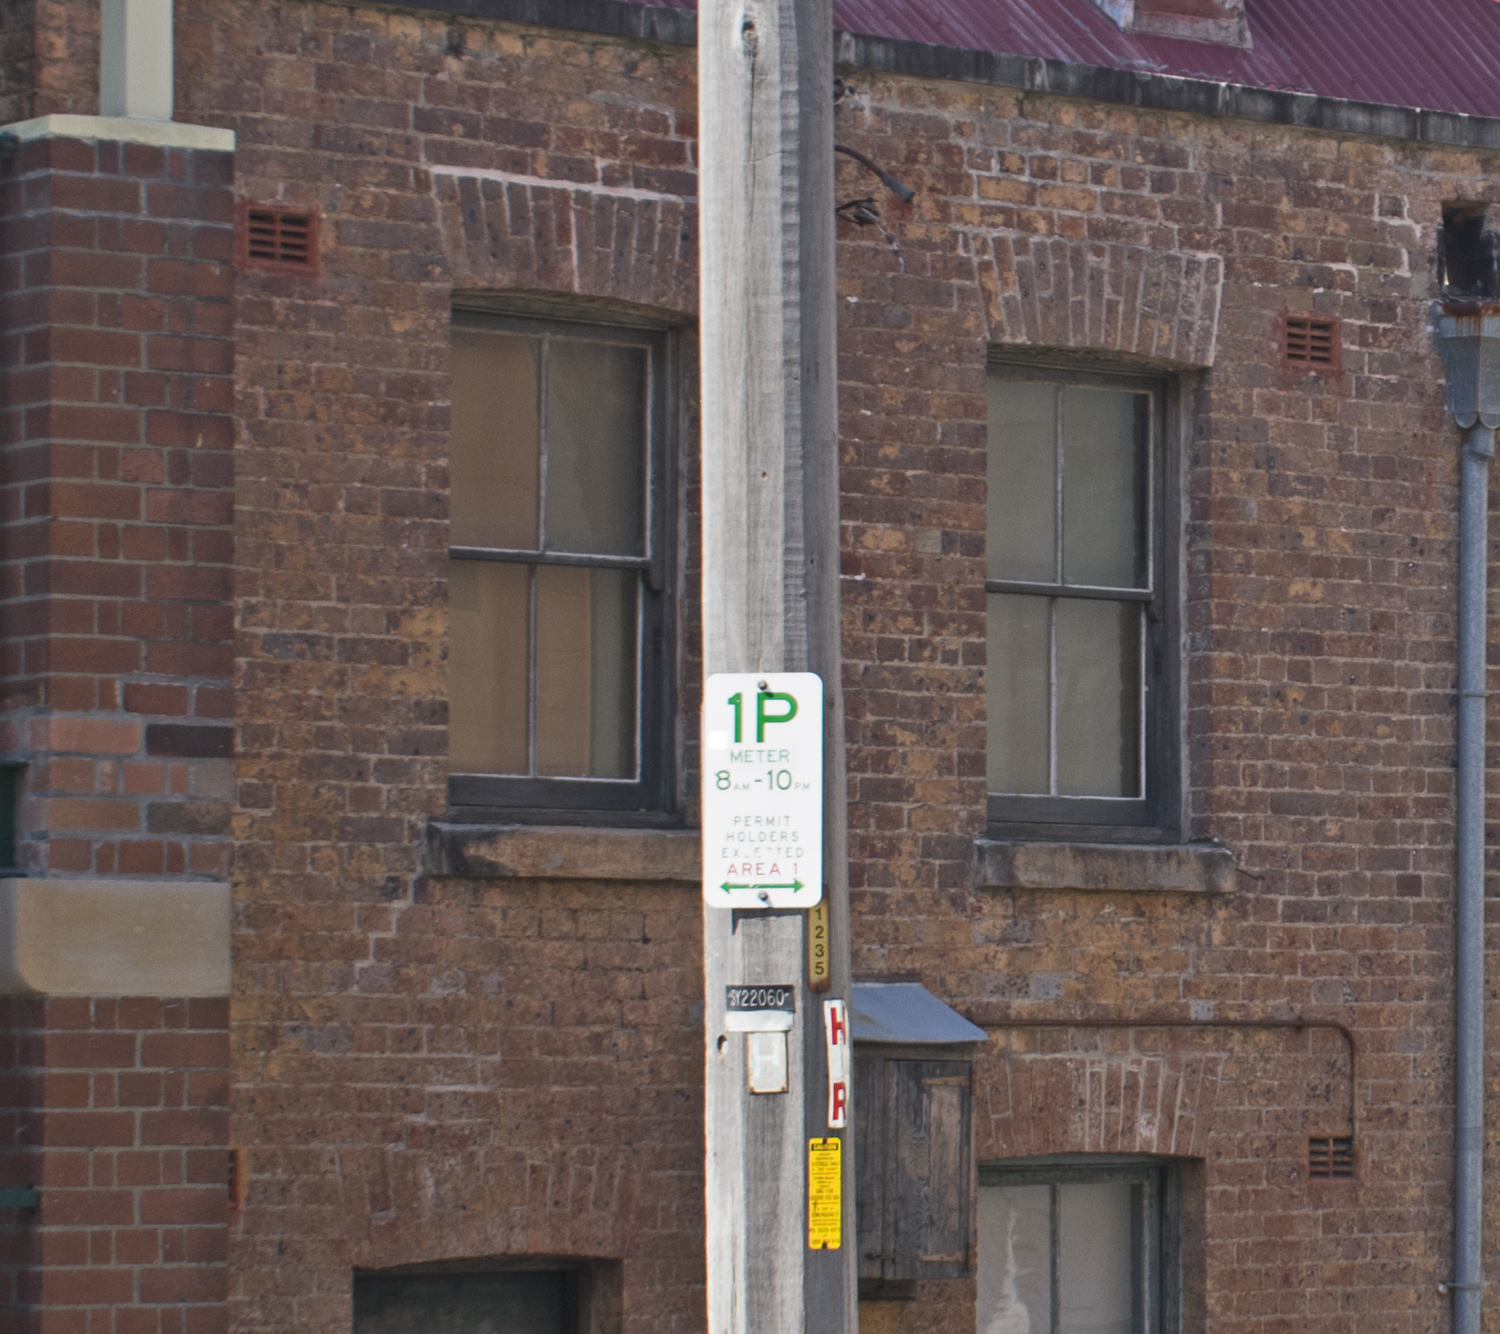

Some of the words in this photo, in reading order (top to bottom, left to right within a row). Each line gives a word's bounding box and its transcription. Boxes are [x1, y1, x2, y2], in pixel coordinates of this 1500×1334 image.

[727, 692, 798, 743] 1P
[730, 749, 790, 763] METER
[734, 815, 791, 827] PERMIT
[726, 831, 799, 843] HOLDERS
[727, 862, 781, 876] AREA
[793, 862, 798, 875] 1
[755, 1038, 781, 1078] H
